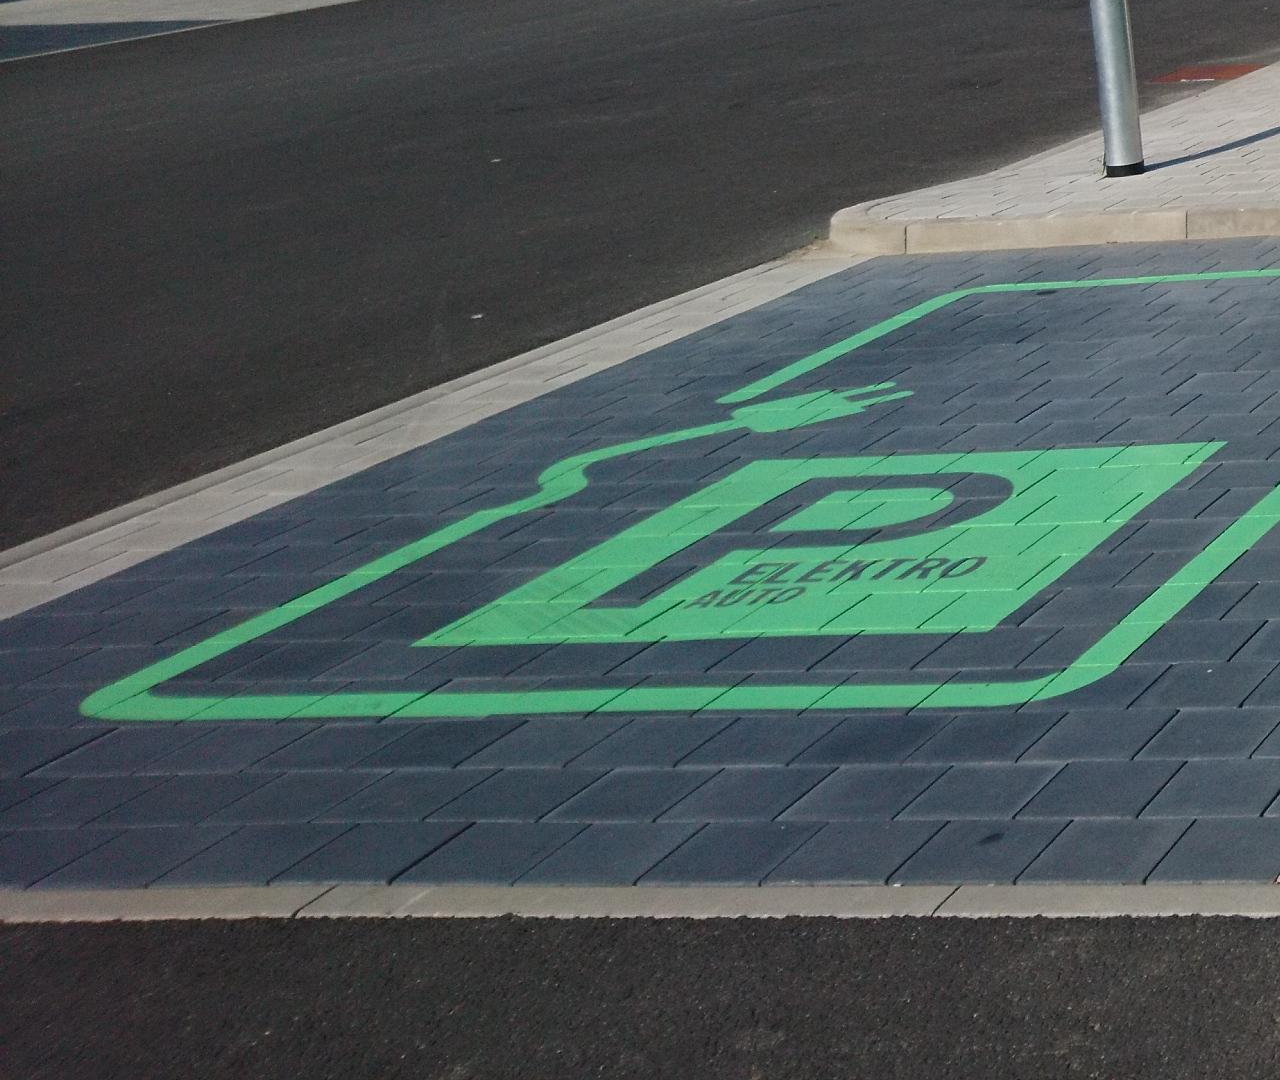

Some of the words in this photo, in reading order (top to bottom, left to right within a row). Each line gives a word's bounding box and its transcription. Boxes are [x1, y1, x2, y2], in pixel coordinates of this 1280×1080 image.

[583, 471, 1014, 610] P
[727, 555, 988, 586] ELEKTRO
[683, 586, 806, 610] AUTO
